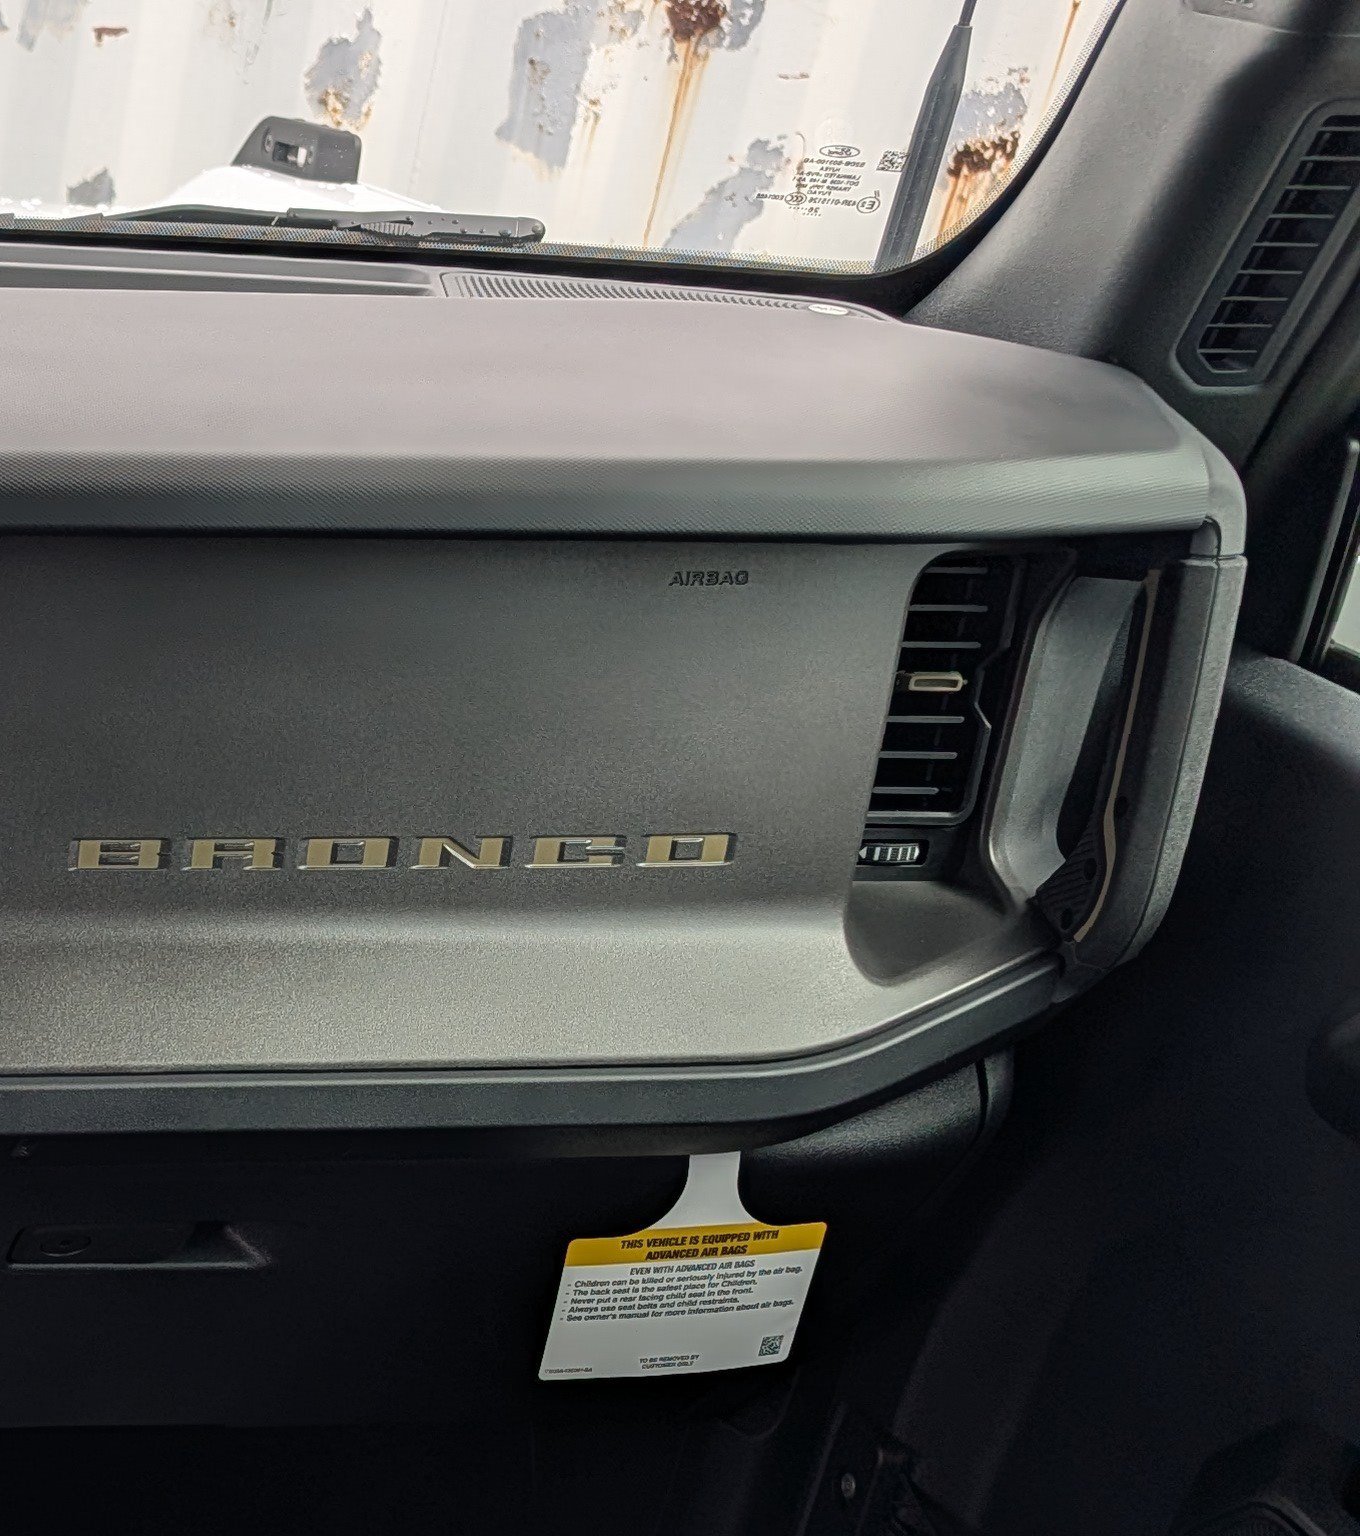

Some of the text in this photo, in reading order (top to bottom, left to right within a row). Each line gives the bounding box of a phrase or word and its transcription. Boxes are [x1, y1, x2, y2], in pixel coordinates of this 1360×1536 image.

[668, 570, 749, 587] AIRBAG
[68, 832, 736, 873] BRONCO
[621, 1230, 779, 1248] THIS VEHICLE IS EQUIPPED WITH
[645, 1245, 747, 1260] ADVANCED AIR BAGS
